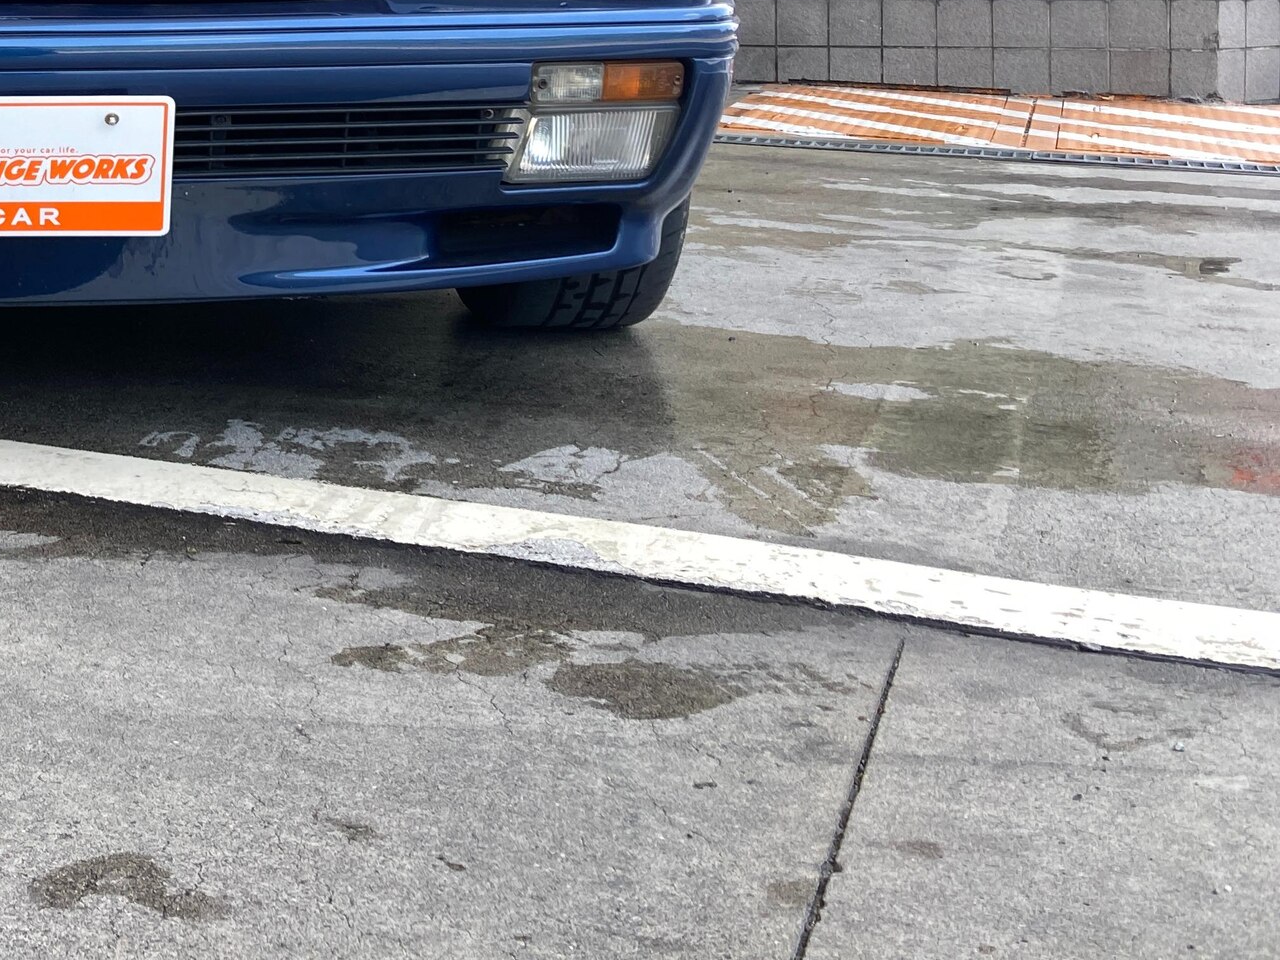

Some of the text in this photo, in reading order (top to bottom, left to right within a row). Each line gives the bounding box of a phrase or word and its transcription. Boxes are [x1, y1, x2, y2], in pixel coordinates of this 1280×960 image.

[14, 147, 37, 155] your
[58, 146, 79, 154] life.
[48, 158, 149, 180] WORKS
